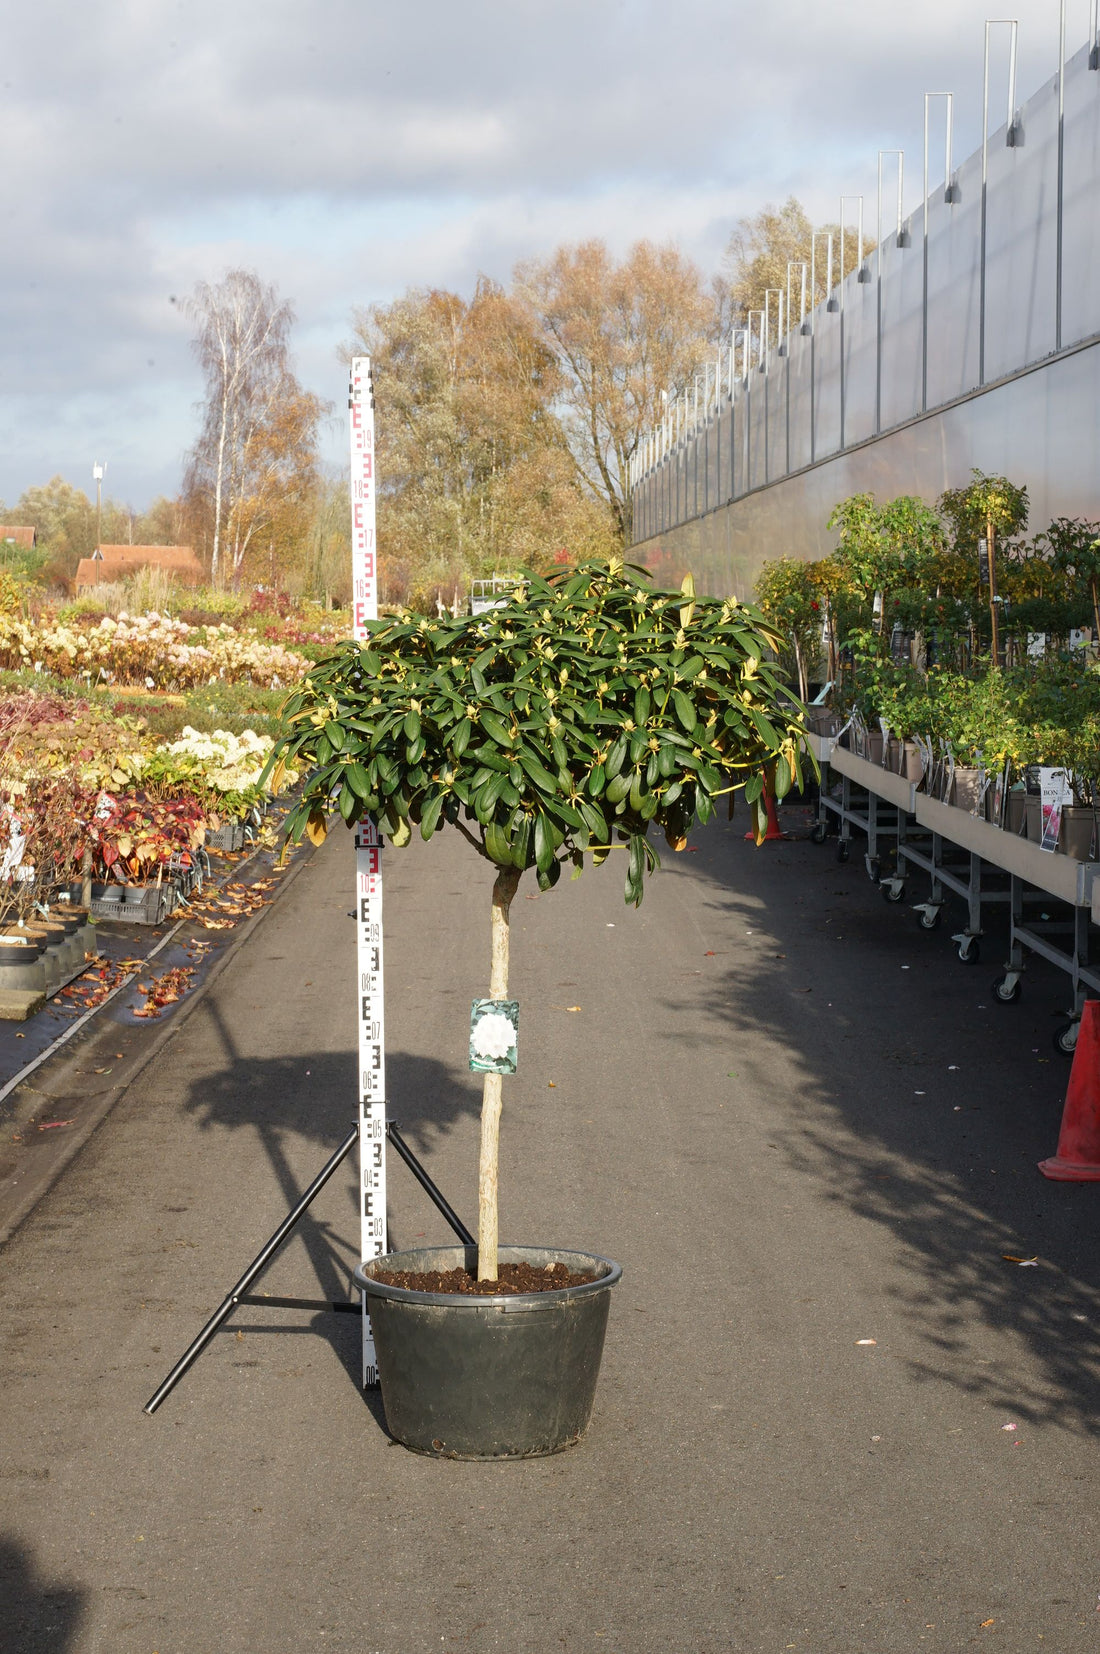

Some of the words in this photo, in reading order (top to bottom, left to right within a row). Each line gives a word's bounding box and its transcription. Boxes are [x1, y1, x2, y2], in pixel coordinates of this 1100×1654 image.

[362, 429, 372, 449] 19
[354, 479, 363, 499] 18
[364, 529, 374, 548] 17
[355, 578, 365, 598] 16
[360, 873, 370, 893] 10
[361, 972, 371, 992] 08
[371, 1021, 381, 1040] 07
[362, 1070, 372, 1090] 06
[372, 1119, 382, 1138] 05
[363, 1169, 373, 1188] 04
[373, 1217, 383, 1237] 03
